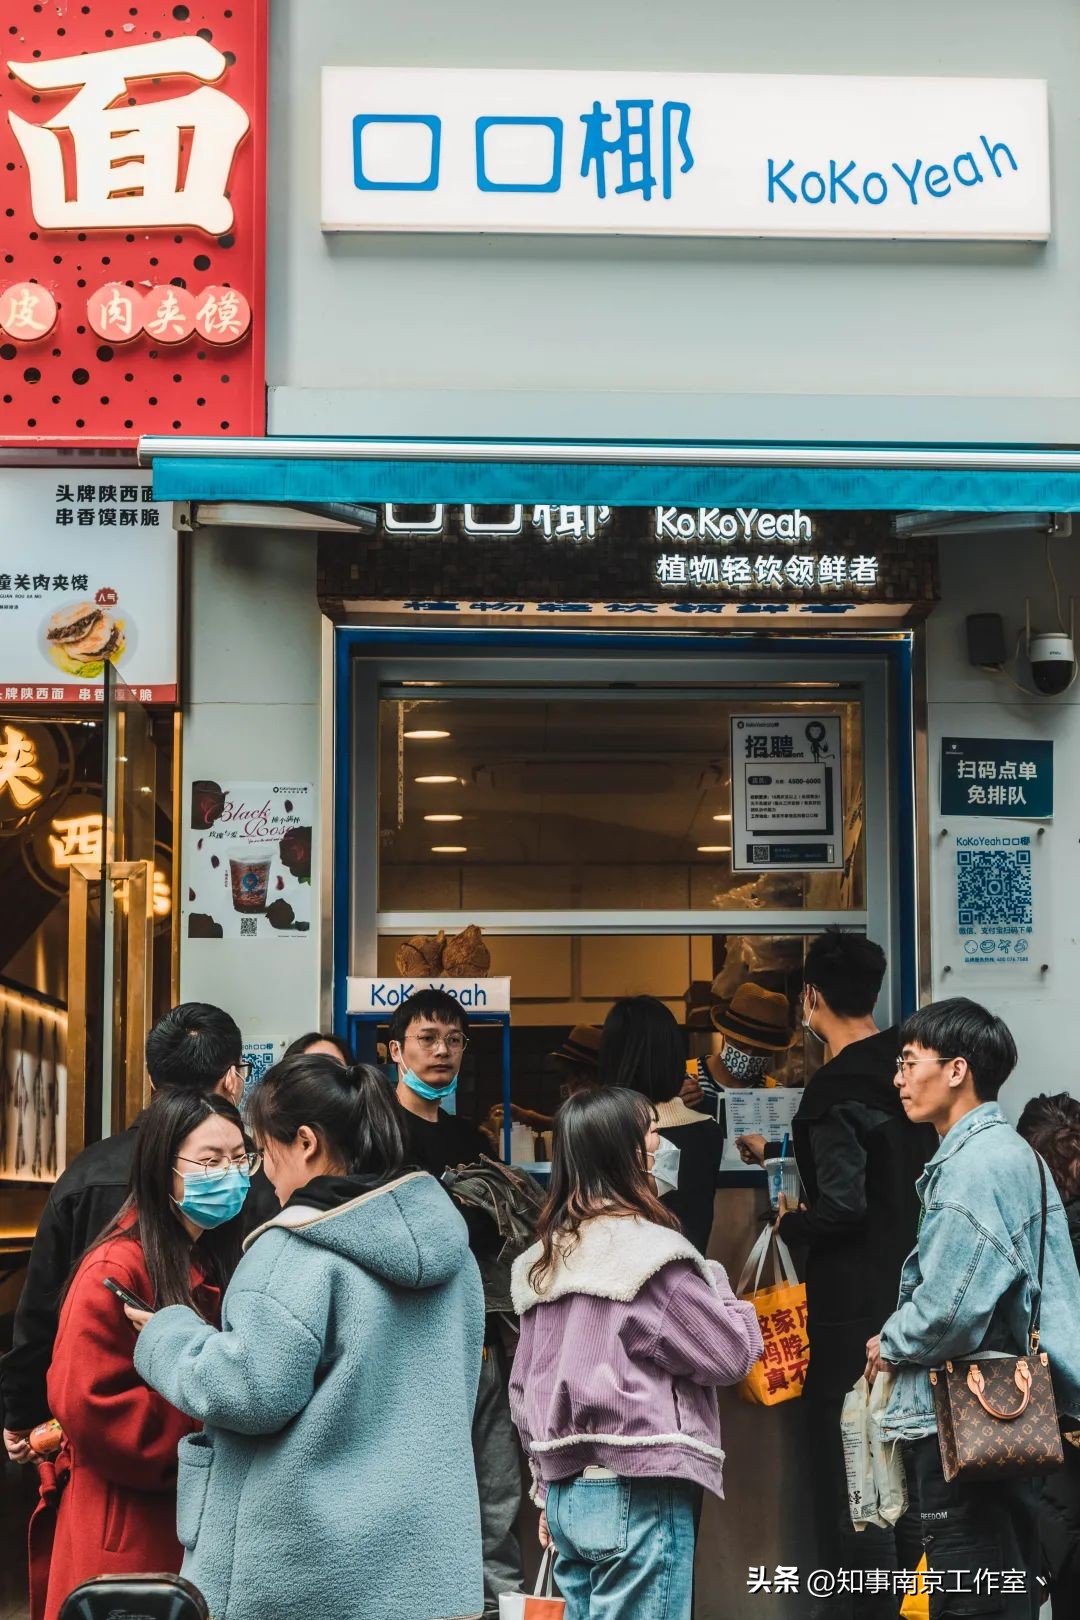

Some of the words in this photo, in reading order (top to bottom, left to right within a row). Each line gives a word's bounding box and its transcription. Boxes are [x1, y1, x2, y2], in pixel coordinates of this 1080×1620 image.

[7, 35, 251, 237] 面
[353, 98, 694, 201] 口口椰
[767, 135, 1018, 205] KoKoYeah
[4, 288, 49, 331] 皮
[100, 288, 243, 336] 肉夹馍
[56, 508, 160, 526] 串香馍酥脆
[655, 506, 812, 540] KoKoYeah
[656, 554, 878, 585] 植物轻饮领鲜者
[0, 687, 64, 700] 牌陕西面
[79, 688, 152, 701] 串香脆
[745, 735, 794, 758] 招聘
[957, 760, 1038, 780] 扫码点单
[967, 785, 1027, 805] 免排队
[204, 799, 271, 824] Black
[244, 816, 295, 837] Rose
[371, 983, 487, 1006] KoKeah
